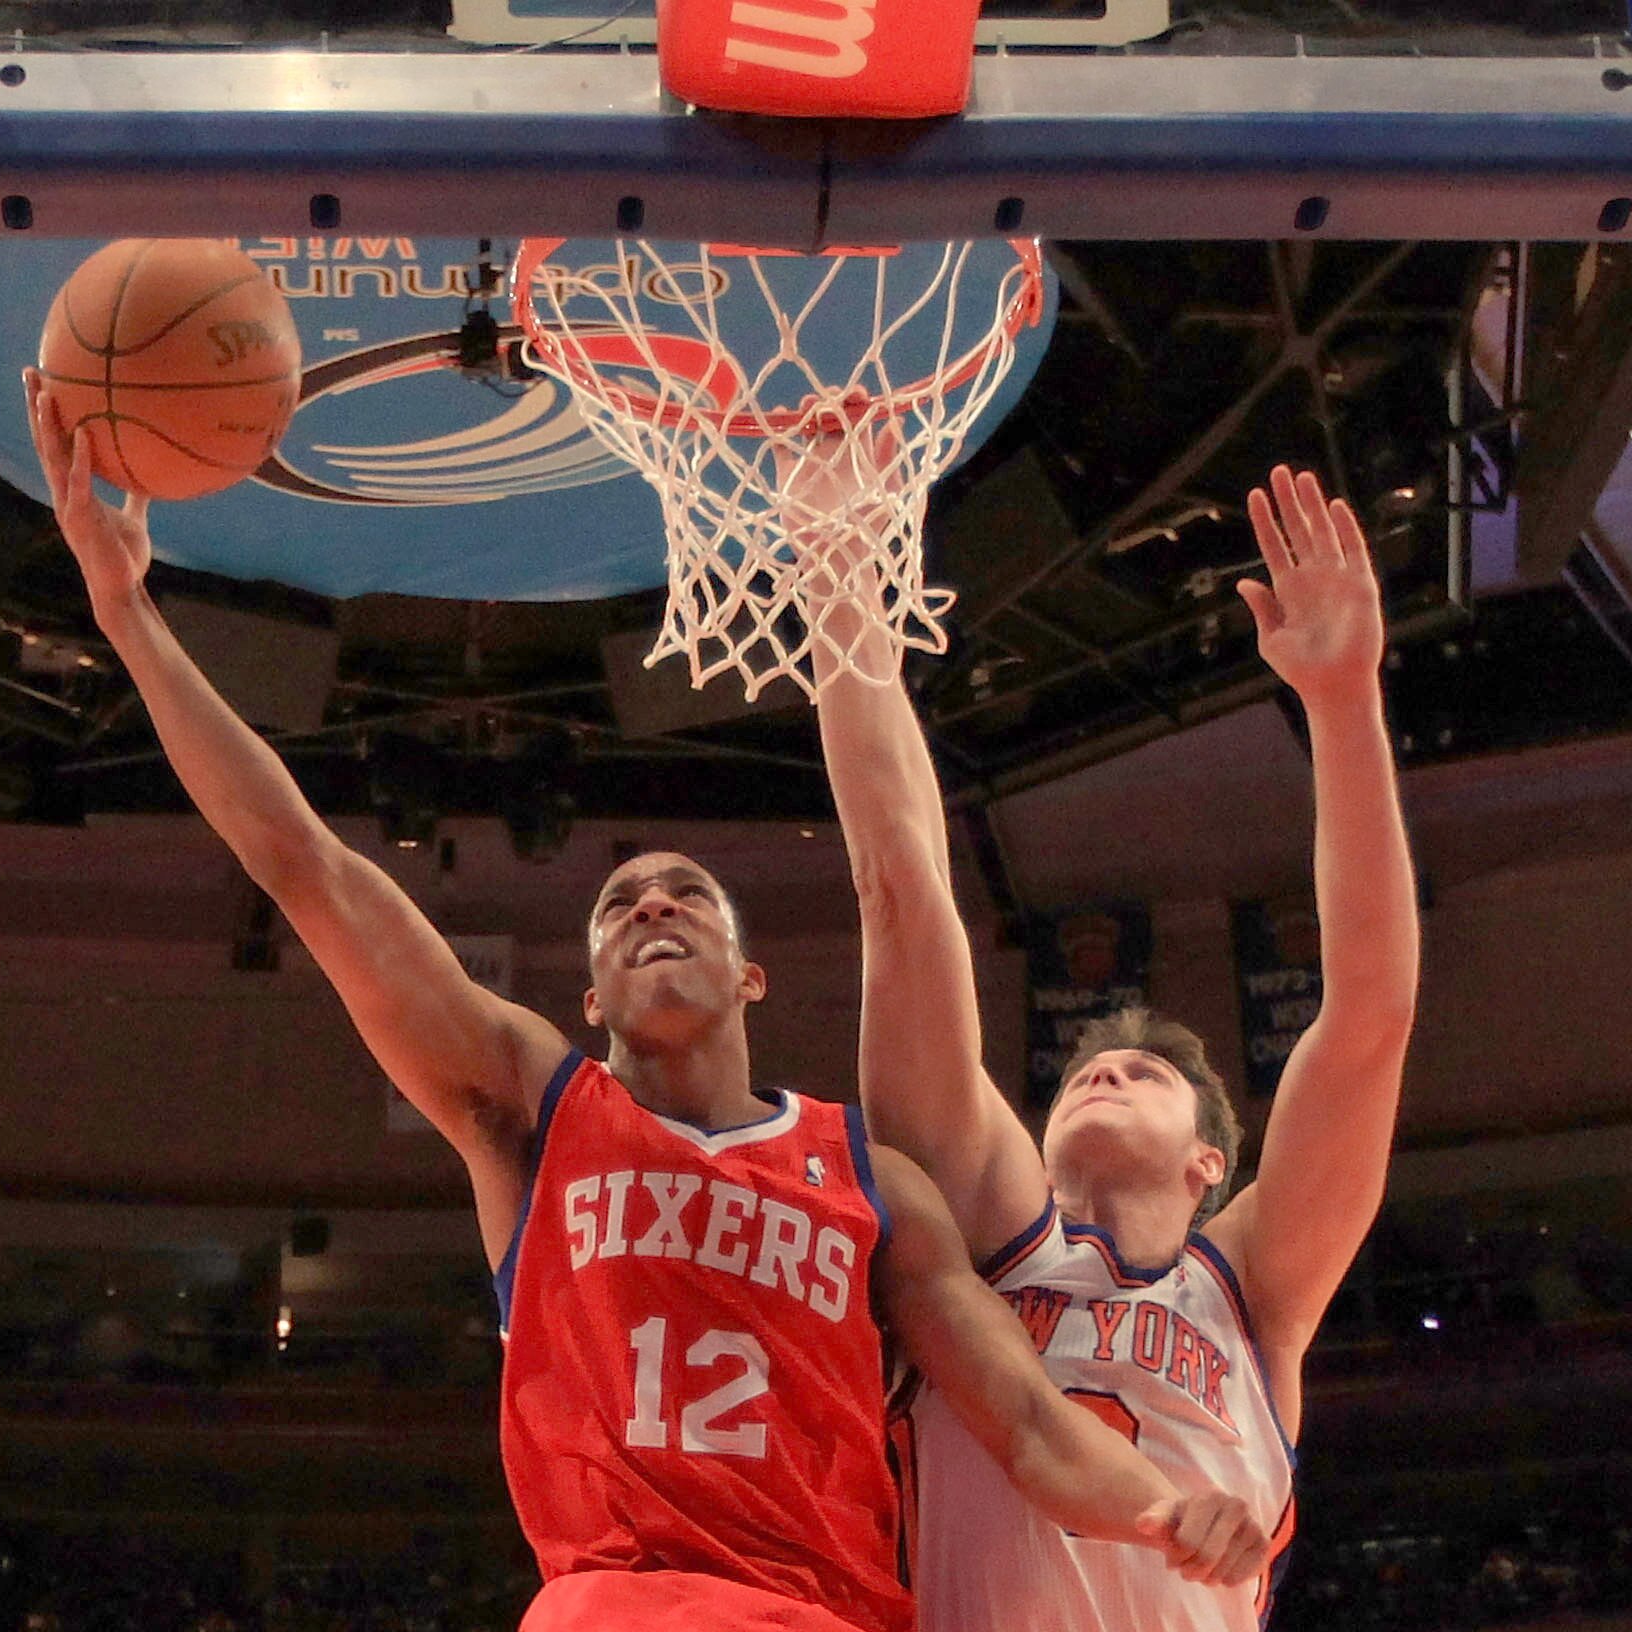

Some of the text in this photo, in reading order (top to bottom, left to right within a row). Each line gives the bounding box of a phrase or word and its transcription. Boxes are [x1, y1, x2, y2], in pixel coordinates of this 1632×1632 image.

[564, 1170, 857, 1323] SIXERS
[626, 1316, 770, 1459] 12
[1087, 1299, 1241, 1438] YORK
